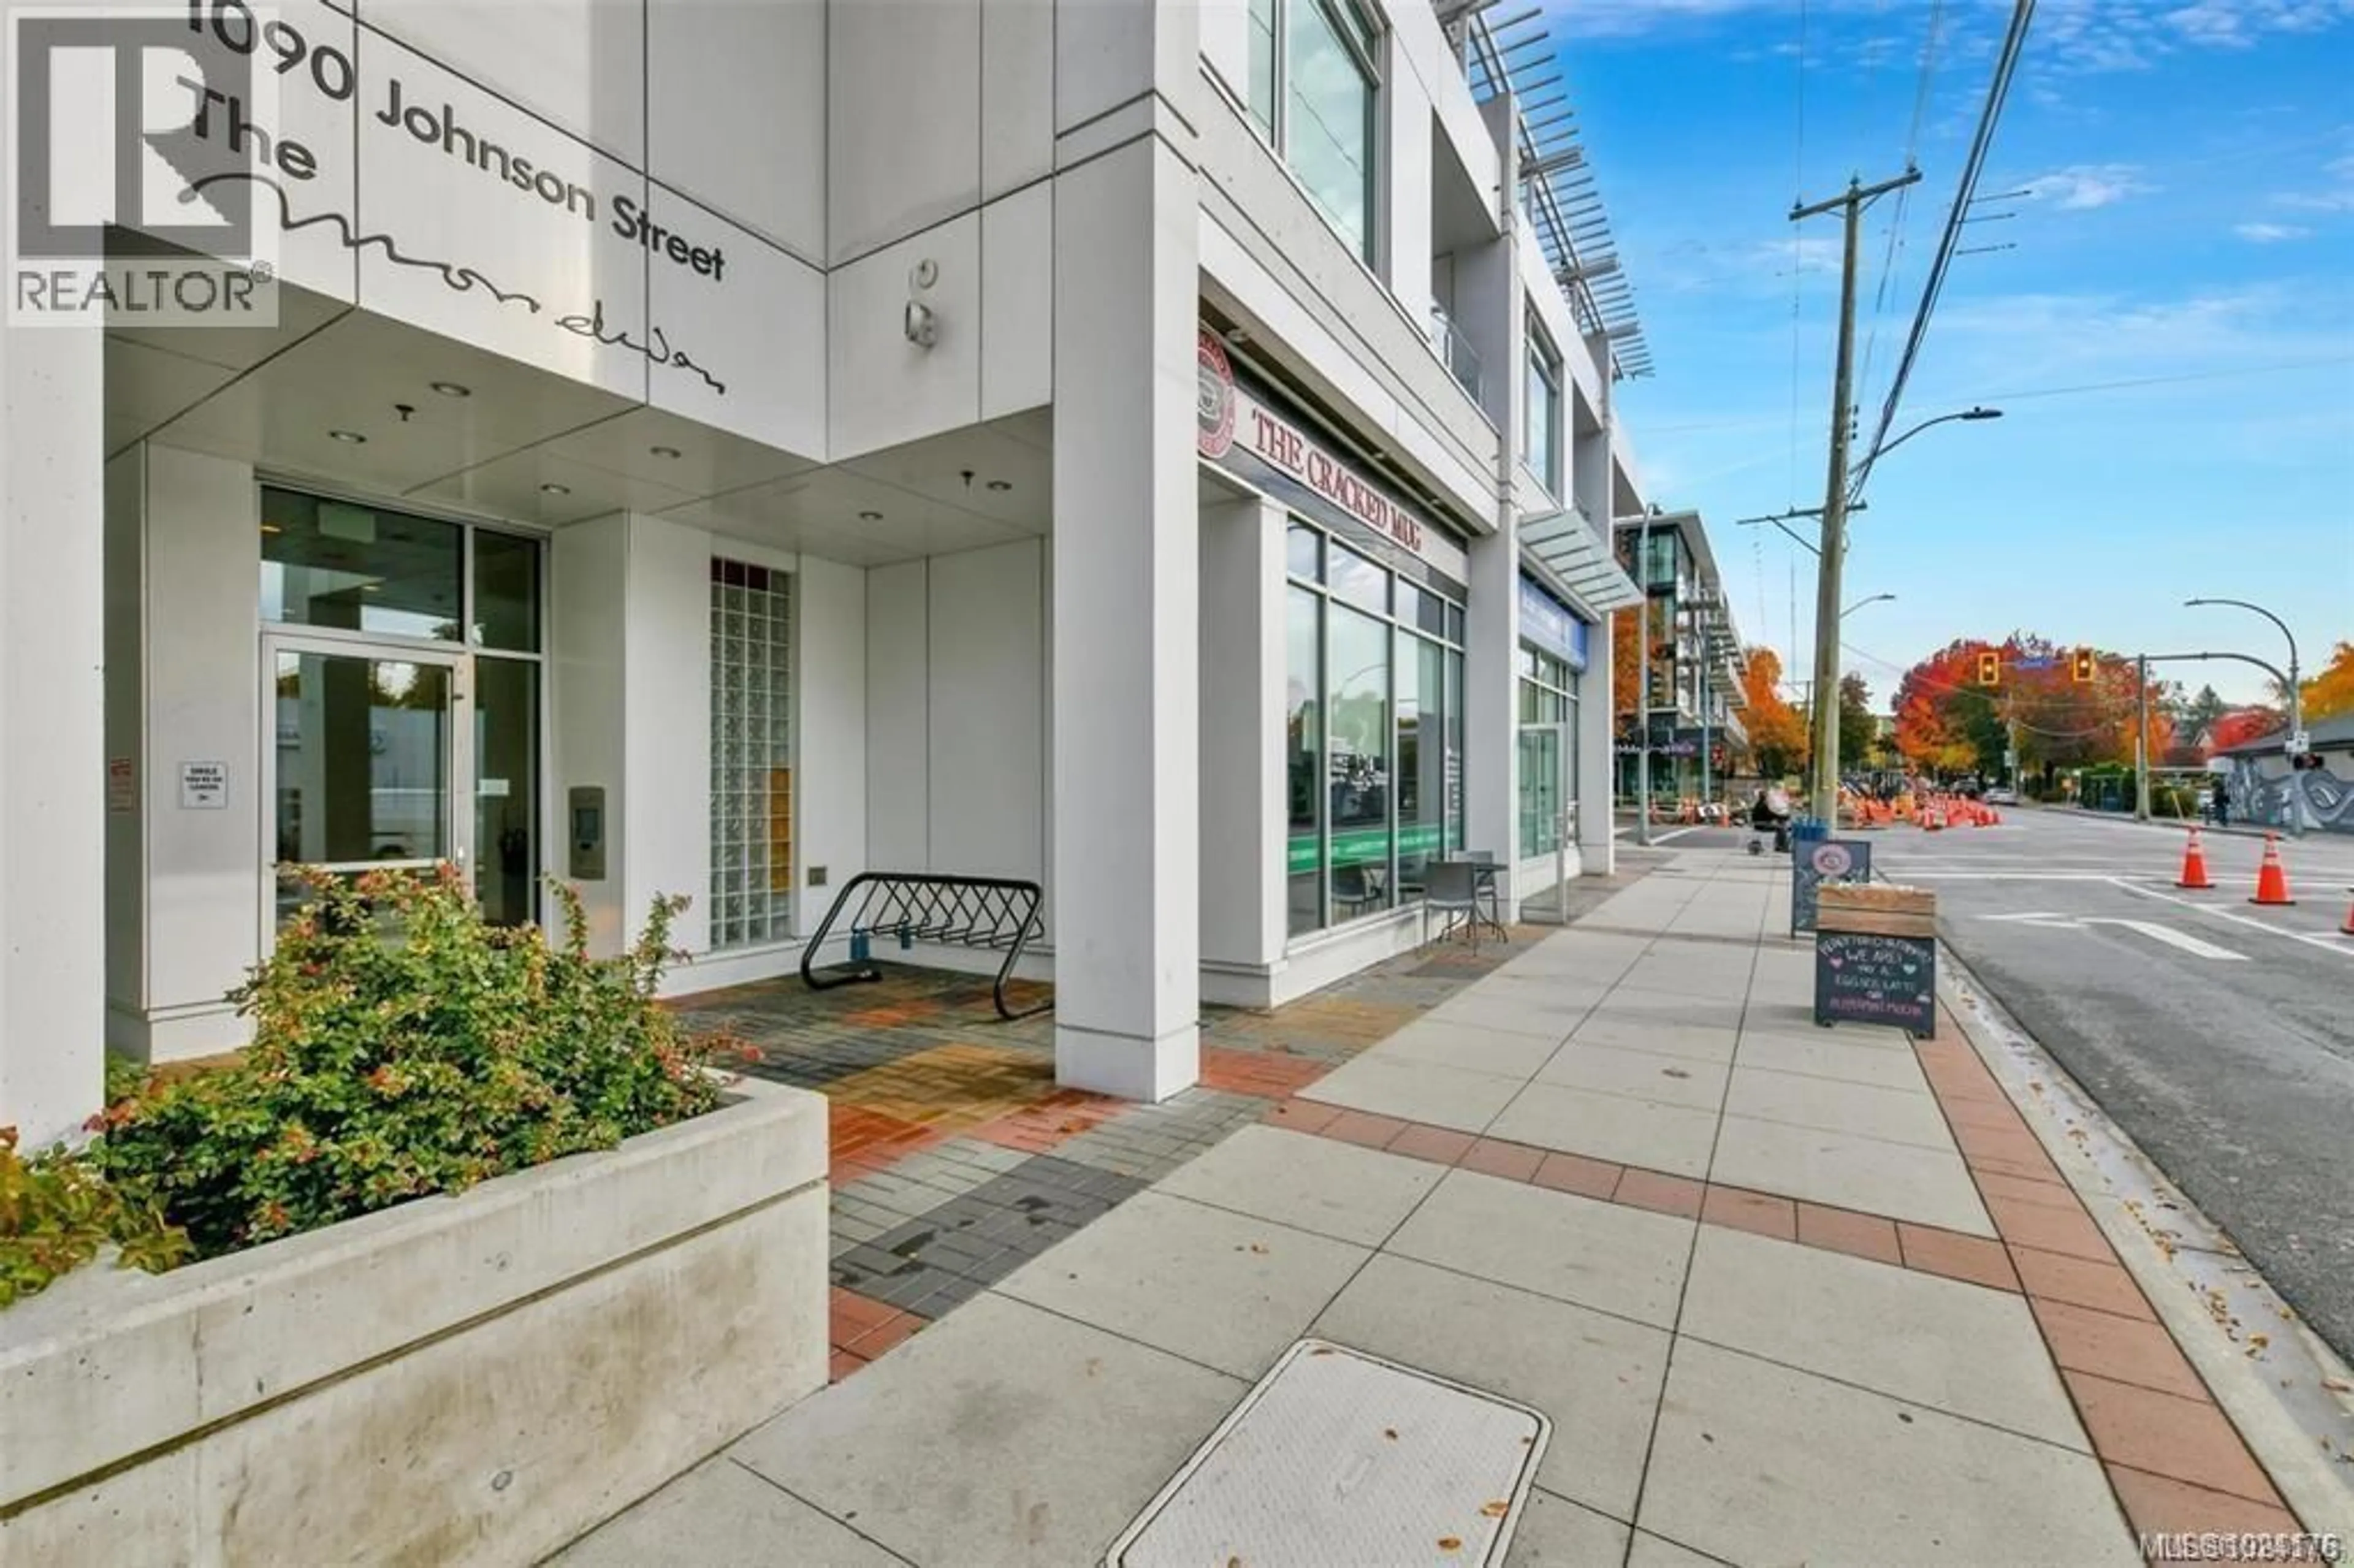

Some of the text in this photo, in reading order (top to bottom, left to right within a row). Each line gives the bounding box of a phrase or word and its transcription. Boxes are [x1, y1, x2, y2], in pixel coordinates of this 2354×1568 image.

[177, 75, 317, 180] The
[376, 79, 595, 221] Johnson
[612, 194, 725, 281] Street
[1252, 408, 1421, 551] THE CRACKED MUG
